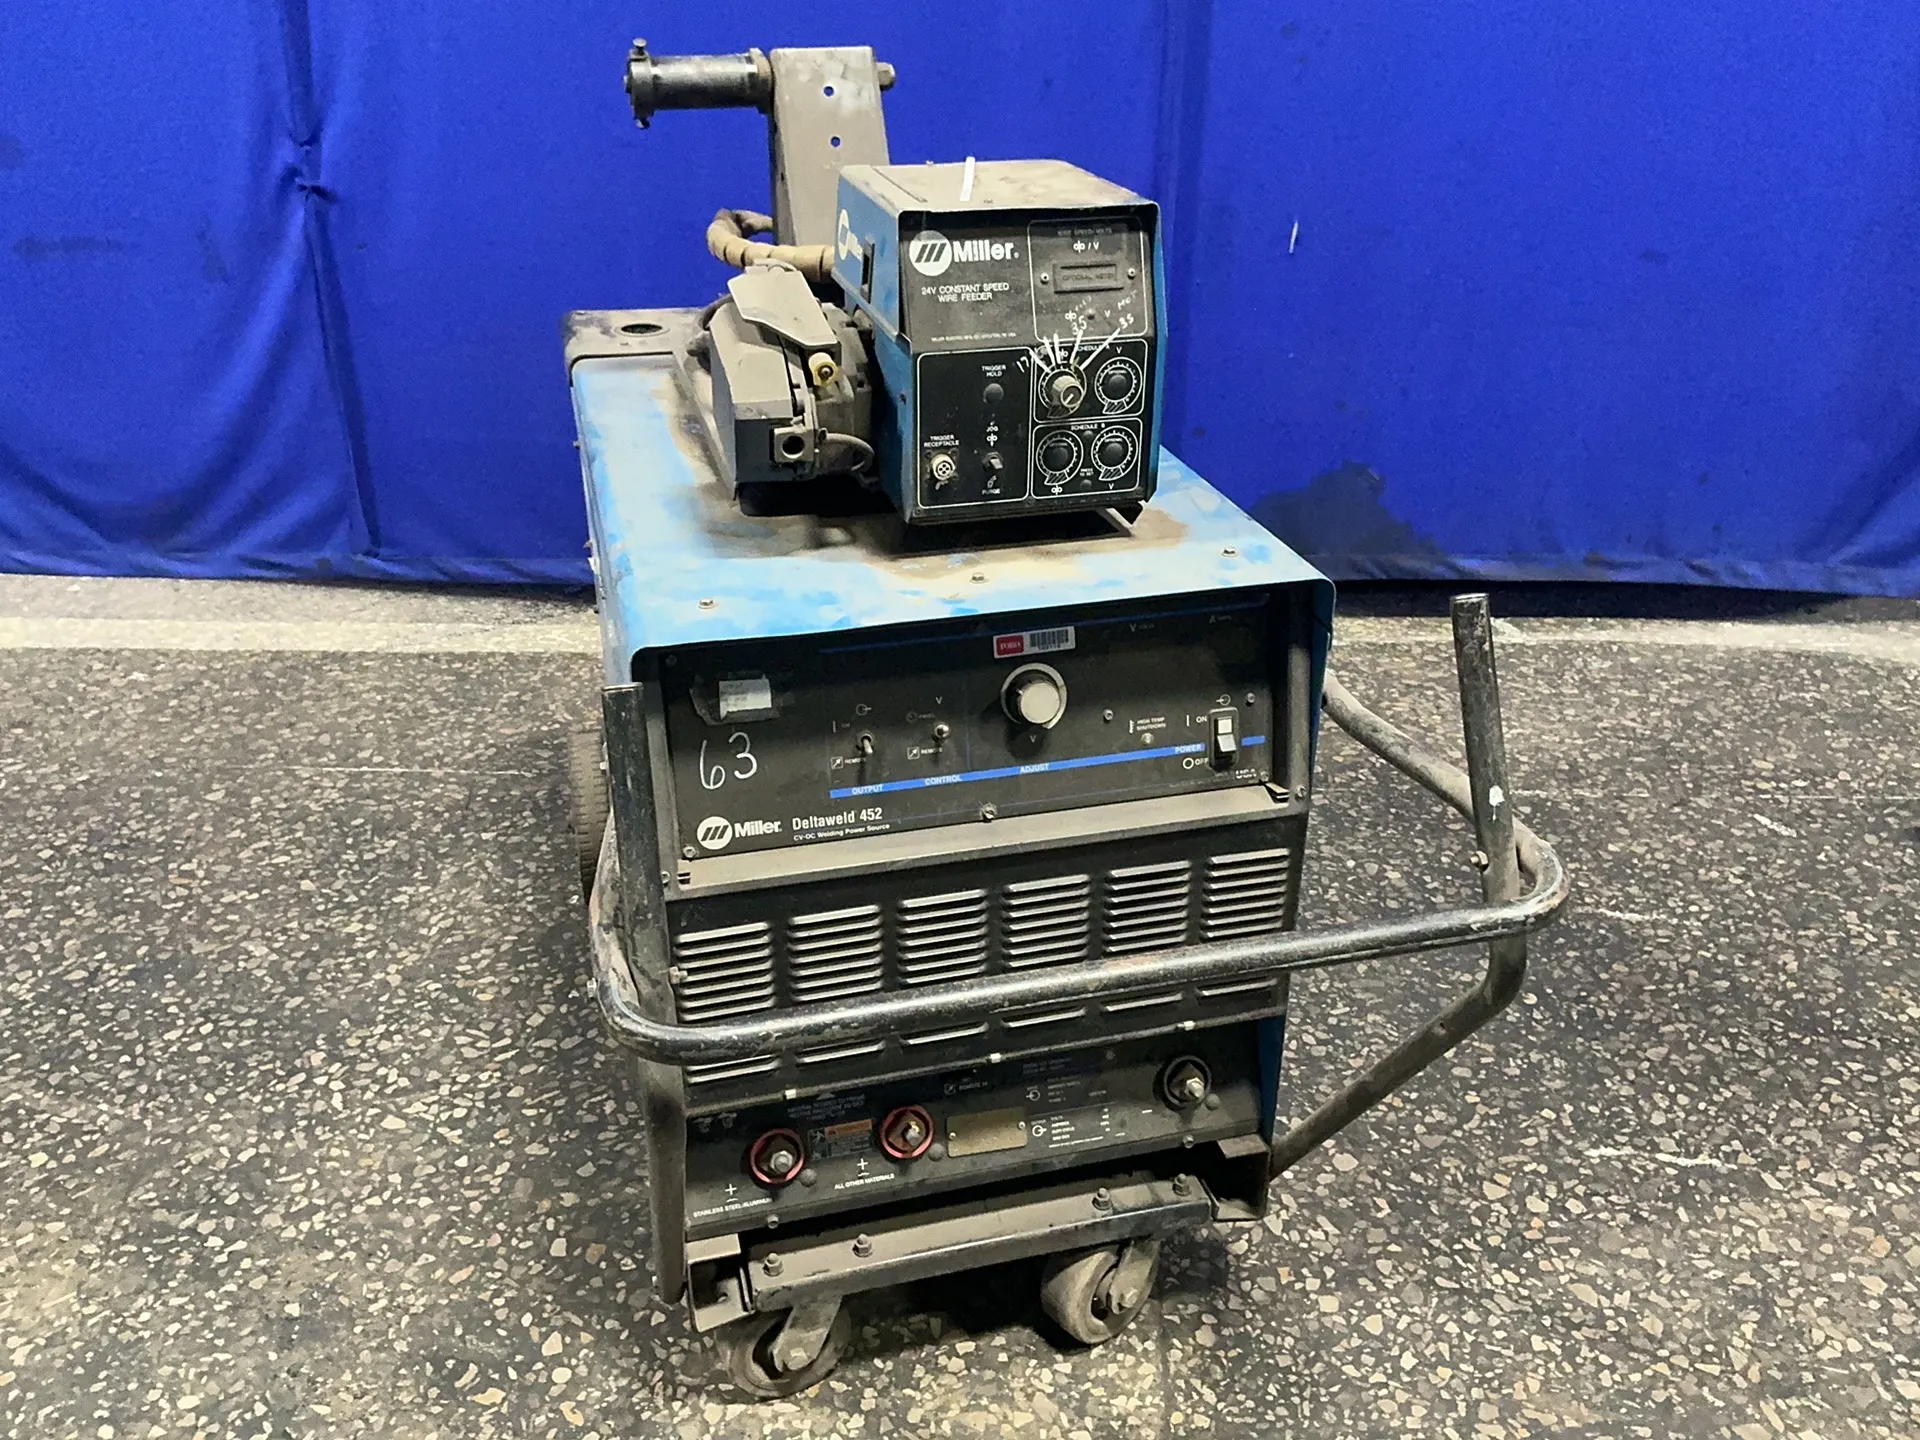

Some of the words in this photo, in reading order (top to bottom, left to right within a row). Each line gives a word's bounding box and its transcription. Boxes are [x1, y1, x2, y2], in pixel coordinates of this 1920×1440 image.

[921, 287, 936, 296] 24V
[938, 284, 981, 295] CONSTANT
[982, 282, 1010, 292] SPEED
[938, 293, 959, 302] WIRE
[961, 291, 993, 301] FEEDER
[981, 364, 1007, 372] TRIGGER
[1071, 423, 1098, 431] SCHEDULE
[930, 434, 955, 442] TRIGGER
[924, 440, 960, 448] RECEPTACLE
[1196, 715, 1207, 723] ON
[1174, 743, 1202, 754] POWER
[699, 732, 757, 790] 63
[1194, 757, 1209, 766] OFF
[1020, 762, 1050, 774] ADJUST
[924, 774, 963, 786] CONTROL
[852, 784, 884, 795] OUTPUT
[792, 811, 856, 831] Deltaweld
[859, 807, 883, 821] 452
[817, 829, 844, 839] Welding
[845, 826, 866, 835] Power
[866, 823, 890, 832] Source
[845, 1179, 864, 1188] OTHER
[864, 1173, 895, 1184] MATERIALS
[693, 1206, 724, 1218] STAINLESS
